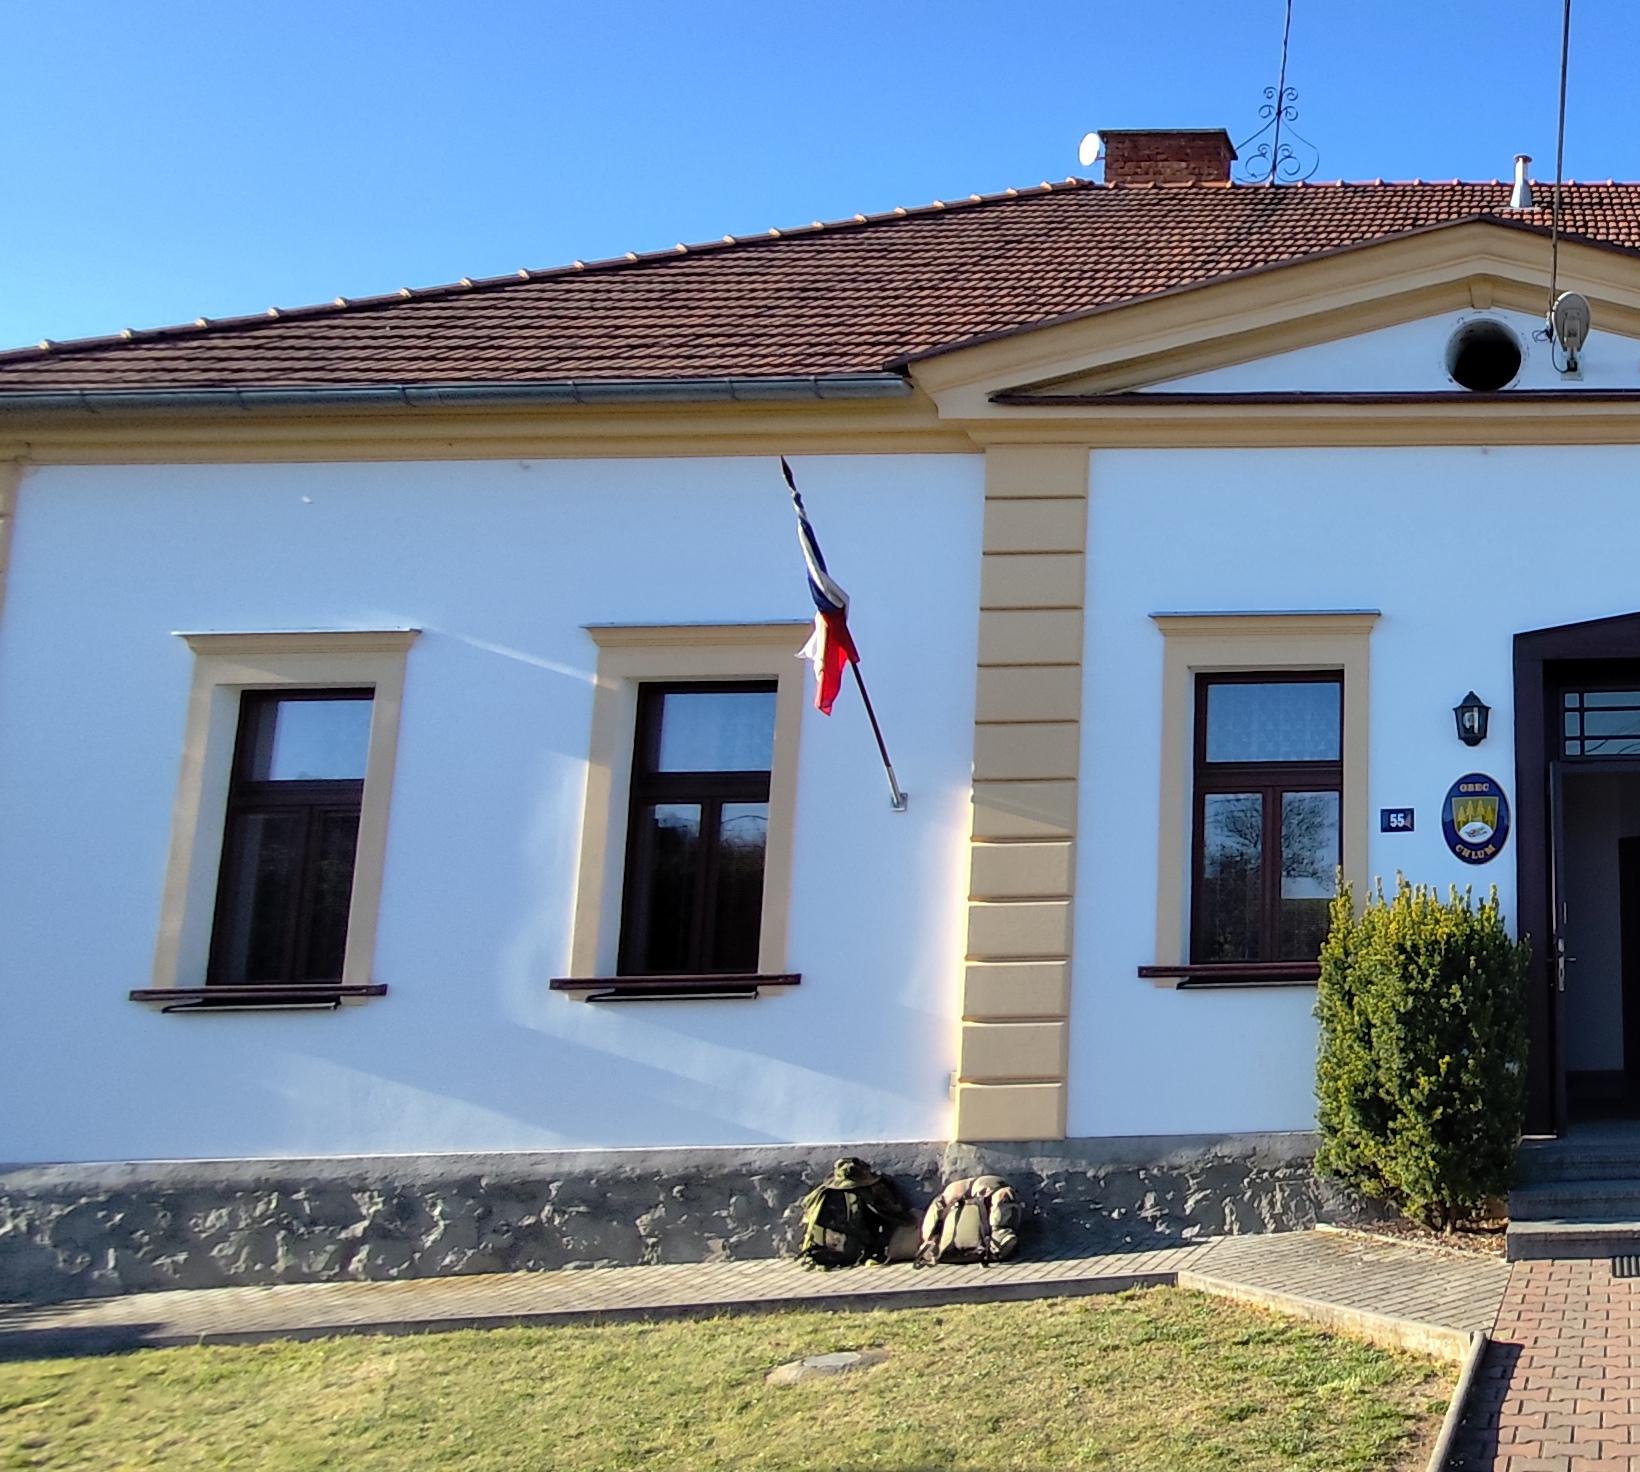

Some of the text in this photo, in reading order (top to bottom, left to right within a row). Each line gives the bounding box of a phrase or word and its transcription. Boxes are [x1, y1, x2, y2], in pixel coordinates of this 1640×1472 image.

[1459, 784, 1490, 792] OBEC
[1390, 813, 1405, 828] 55
[1455, 844, 1496, 859] CHLUM
